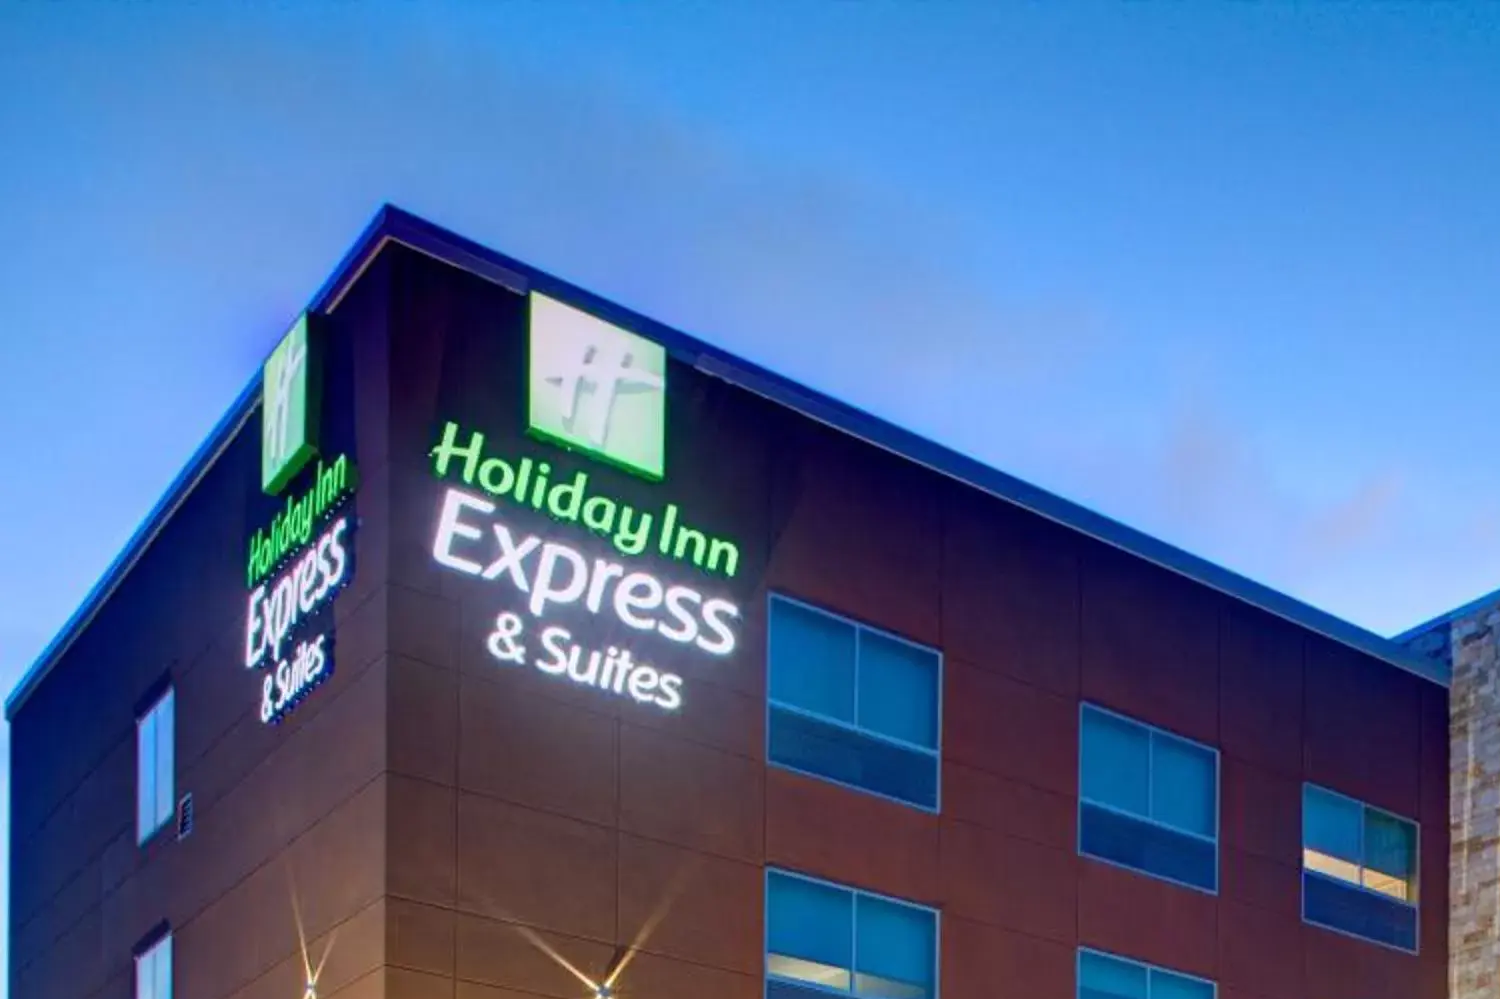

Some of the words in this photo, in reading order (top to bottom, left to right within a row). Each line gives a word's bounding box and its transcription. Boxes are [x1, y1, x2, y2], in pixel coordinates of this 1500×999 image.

[247, 495, 314, 588] Holiday
[315, 453, 347, 516] Inn
[430, 421, 653, 555] Holiday
[658, 503, 740, 578] Inn
[245, 517, 347, 668] Express
[431, 488, 741, 656] Express
[260, 673, 274, 724] &
[274, 633, 326, 711] Suites
[486, 611, 527, 665] &
[534, 626, 684, 710] Suites
